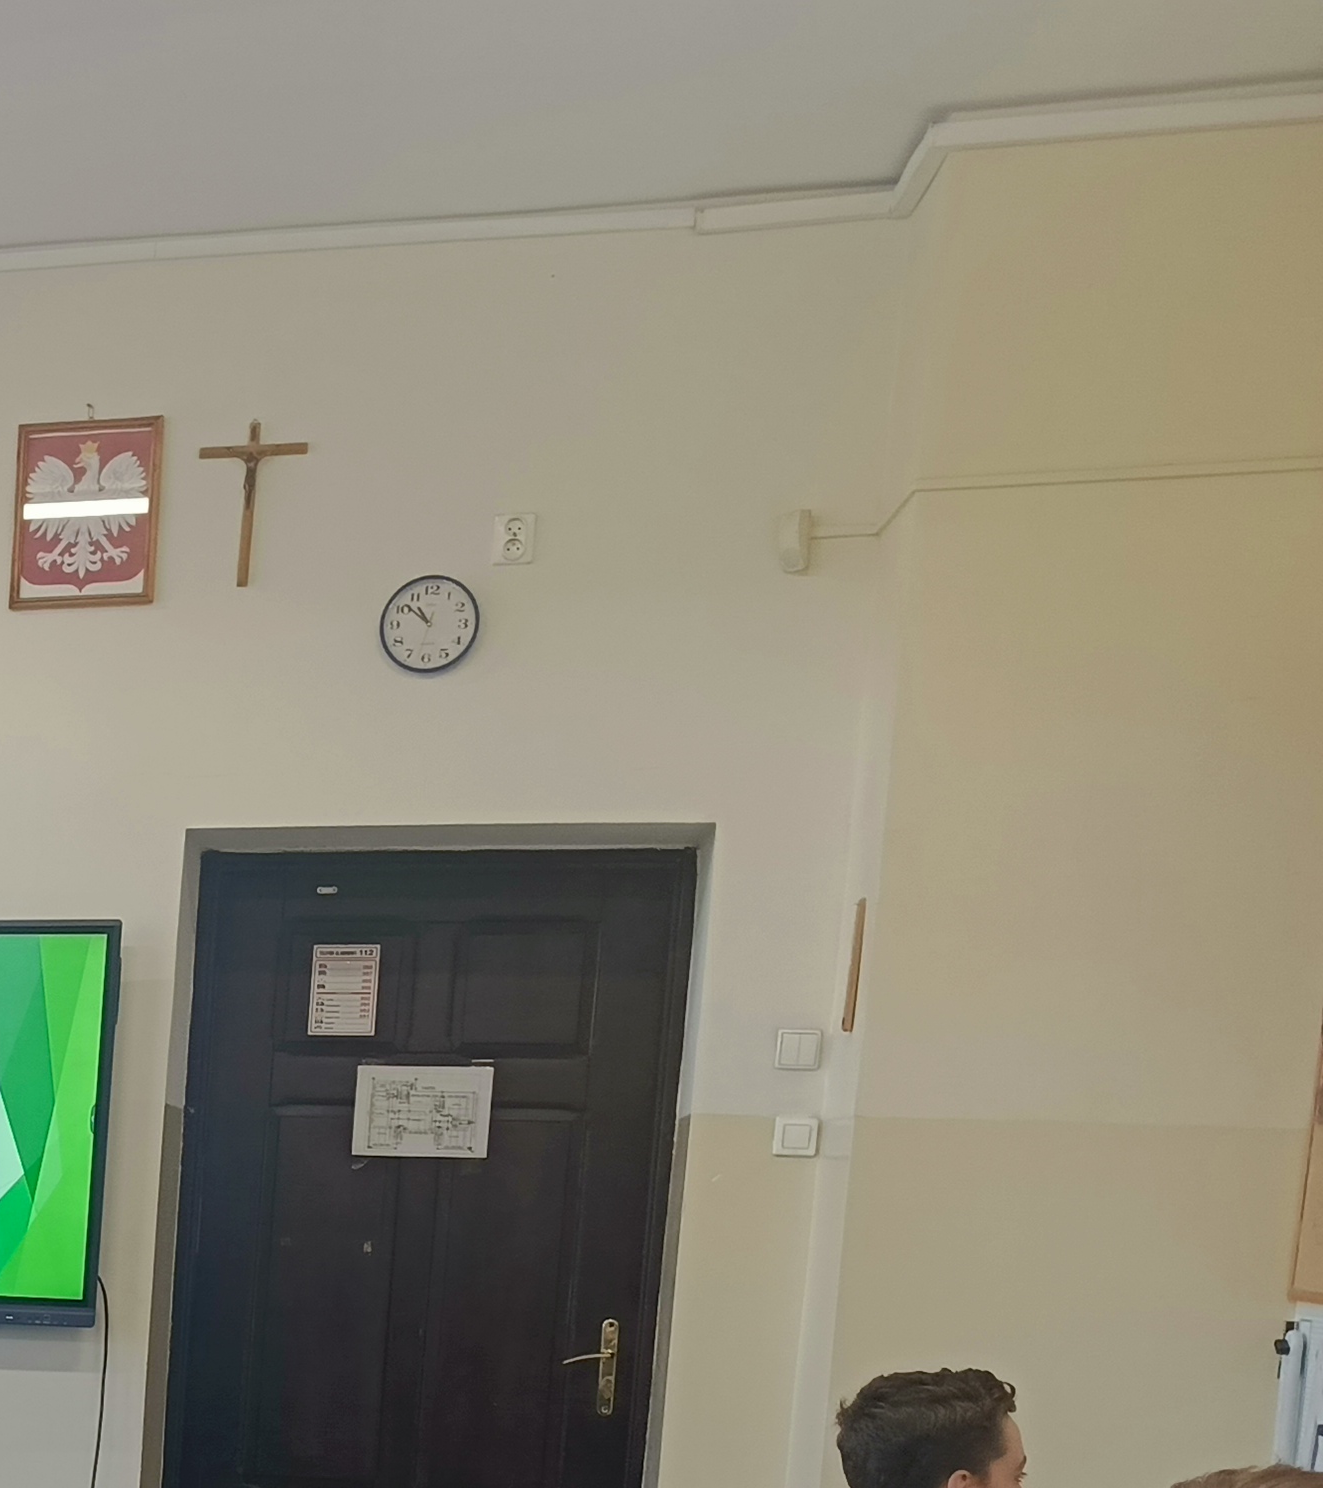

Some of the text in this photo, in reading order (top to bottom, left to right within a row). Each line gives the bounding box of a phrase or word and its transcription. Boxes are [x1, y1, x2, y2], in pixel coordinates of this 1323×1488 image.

[424, 585, 440, 595] 12
[410, 593, 420, 602] 11
[396, 604, 411, 615] 10
[455, 602, 465, 612] 2
[390, 620, 400, 630] 9
[457, 618, 468, 629] 3
[392, 637, 404, 647] 8
[452, 636, 461, 645] 4
[405, 649, 413, 659] 7
[421, 653, 431, 663] 6
[439, 648, 449, 659] 5
